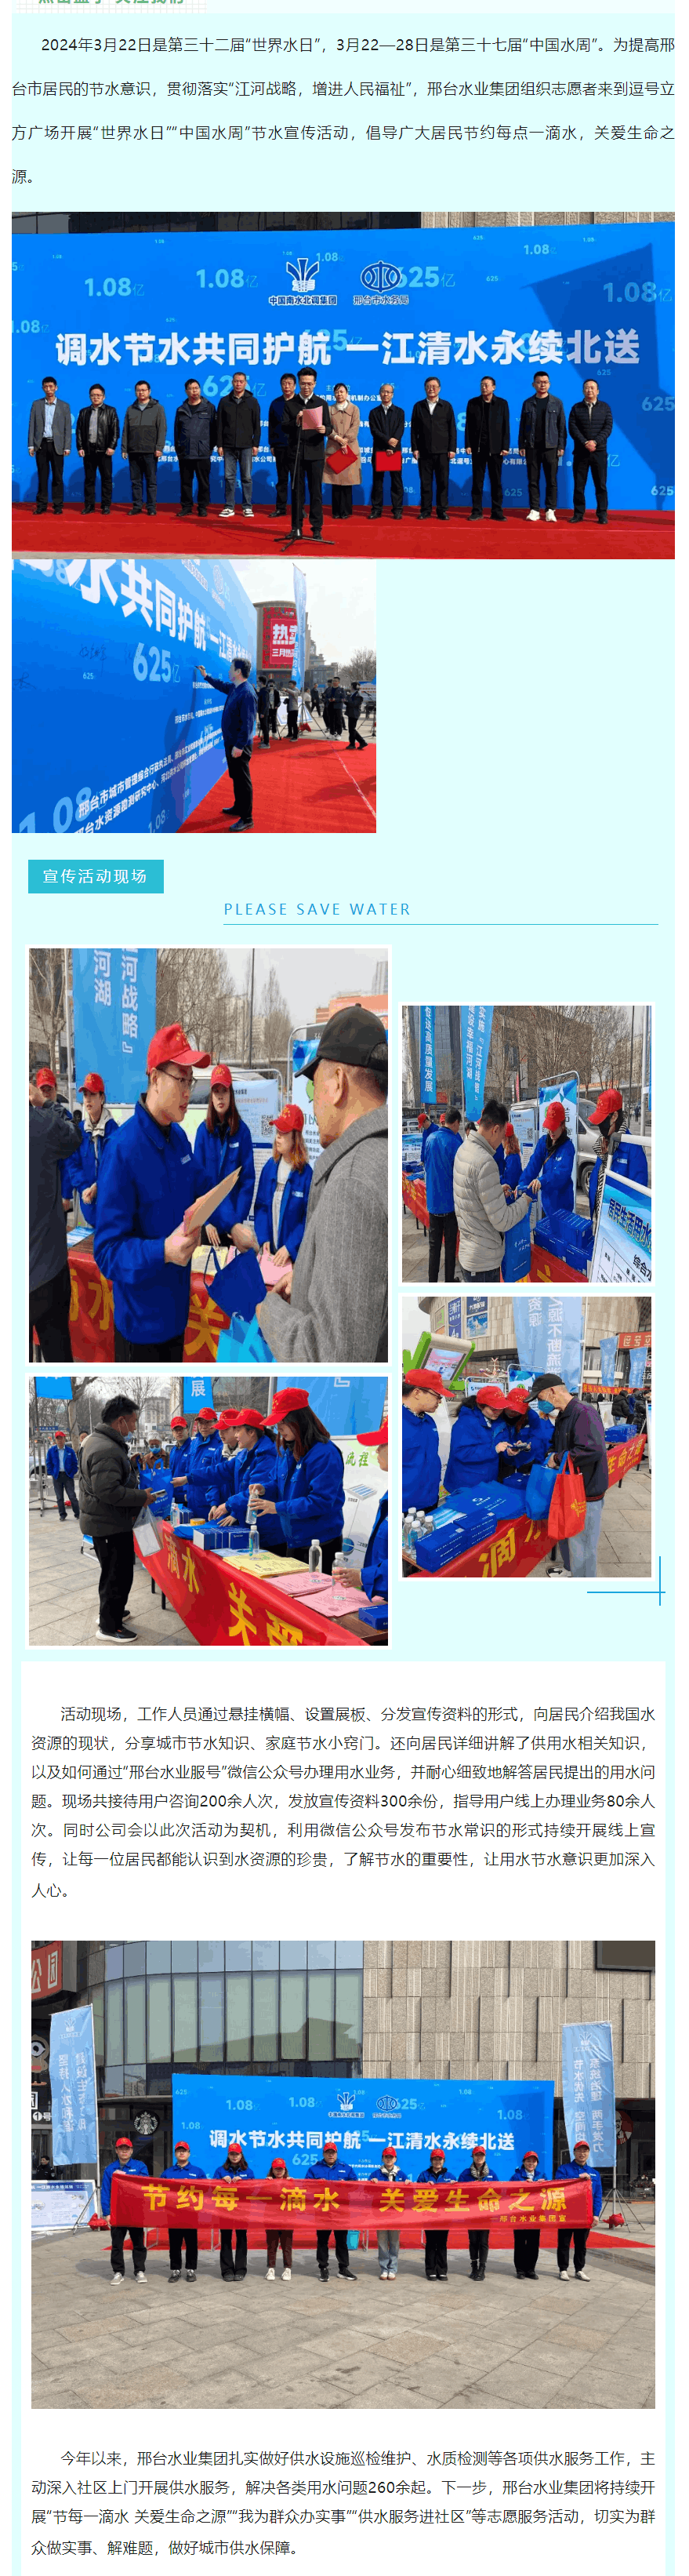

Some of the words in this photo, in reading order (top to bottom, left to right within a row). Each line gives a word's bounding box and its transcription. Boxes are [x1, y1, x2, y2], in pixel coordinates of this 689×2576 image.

[84, 277, 145, 297] 1.08亿
[196, 268, 259, 289] 1.08亿
[269, 294, 338, 306] 中国南水北调集团
[353, 295, 409, 305] 邢台市水务局
[56, 332, 332, 366] 调水节水共同护航
[346, 328, 640, 366] 一江清水永续北送
[209, 2130, 361, 2149] 调水节水共同护航
[368, 2130, 515, 2151] 一江清水永续北送
[141, 2183, 341, 2212] 节约每一滴水
[379, 2187, 568, 2213] 关爱生命之源
